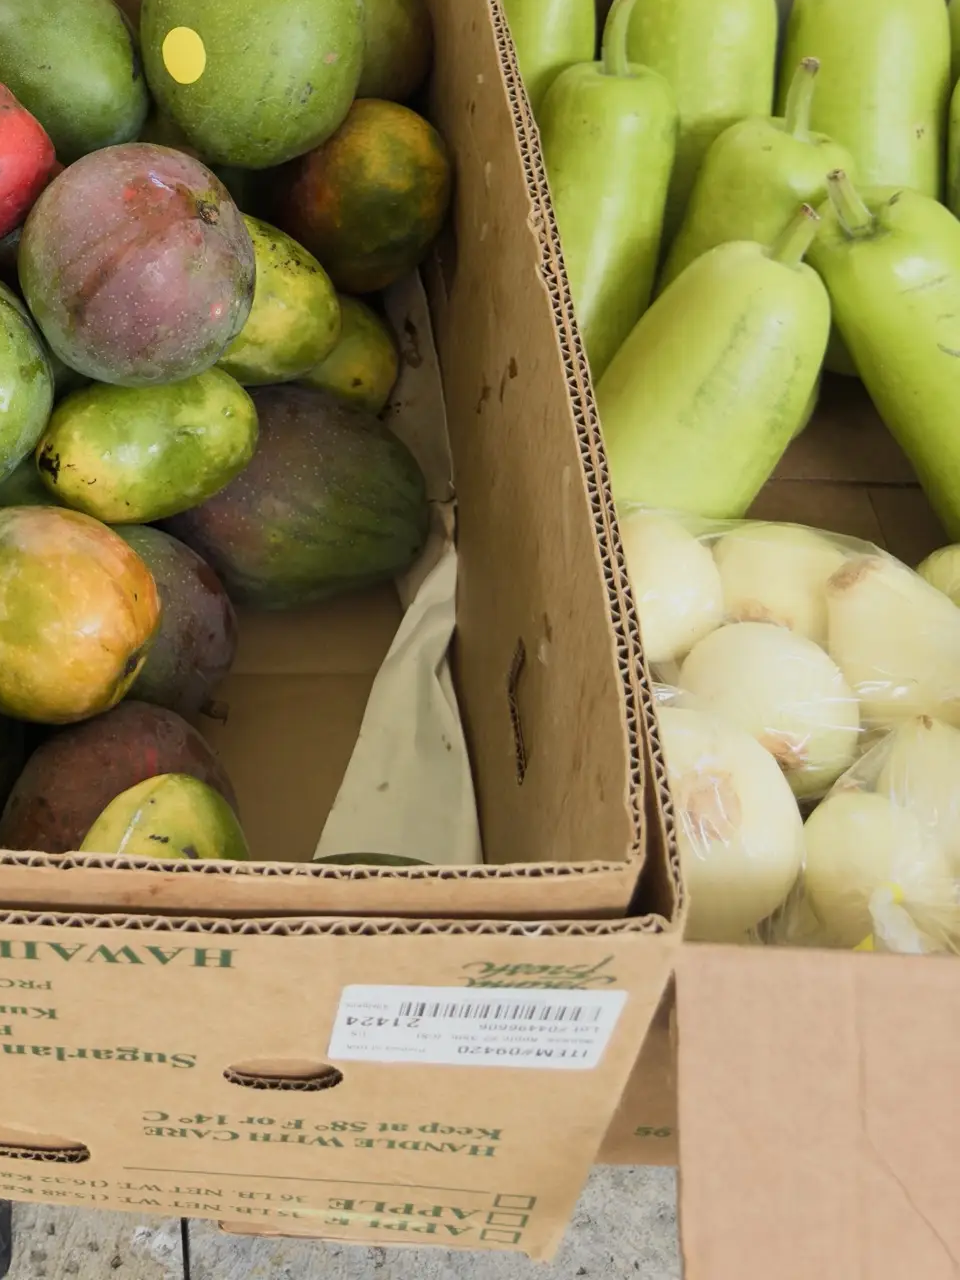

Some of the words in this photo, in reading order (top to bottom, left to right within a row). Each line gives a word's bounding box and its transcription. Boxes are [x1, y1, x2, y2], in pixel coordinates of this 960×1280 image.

[461, 955, 614, 980] Fresh
[345, 1015, 421, 1029] 21424
[141, 1110, 170, 1122] C
[238, 1116, 276, 1127] or
[281, 1115, 306, 1131] F
[142, 1125, 241, 1142] CARE
[377, 1122, 409, 1134] at
[417, 1122, 503, 1142] Keep
[248, 1132, 345, 1149] WITH
[353, 1137, 497, 1158] HANDLE
[117, 1181, 164, 1193] WT.
[171, 1187, 224, 1198] NET
[117, 1196, 162, 1207] WT.
[167, 1200, 222, 1212] NET
[326, 1197, 481, 1221] APPLE
